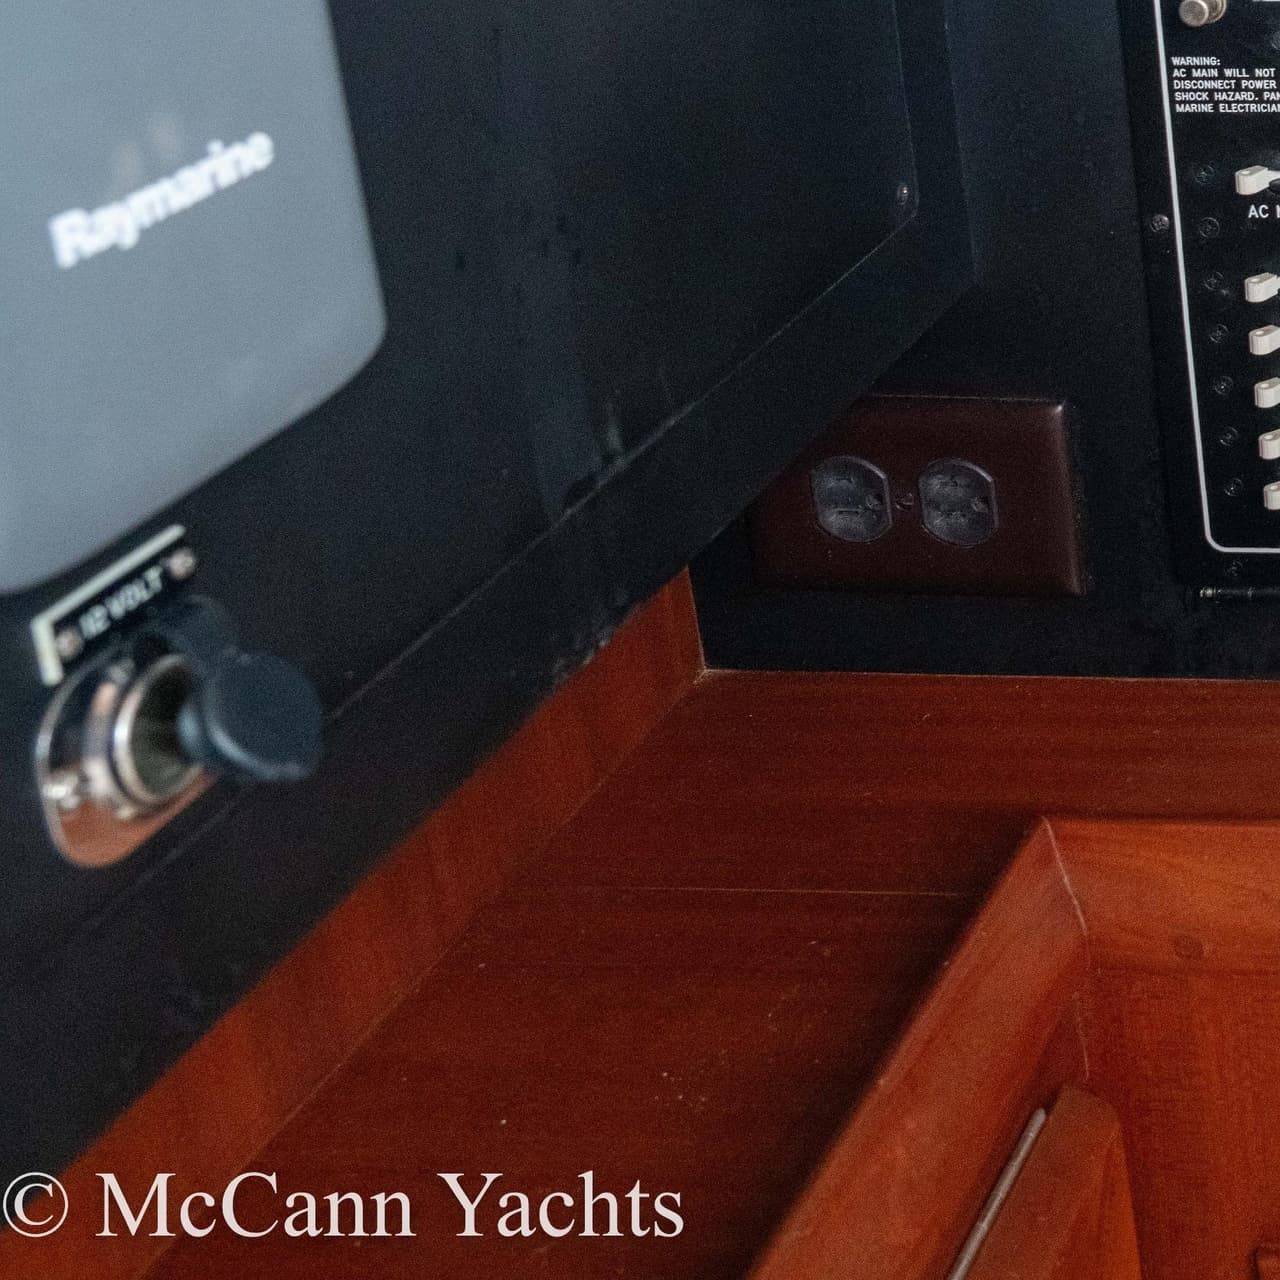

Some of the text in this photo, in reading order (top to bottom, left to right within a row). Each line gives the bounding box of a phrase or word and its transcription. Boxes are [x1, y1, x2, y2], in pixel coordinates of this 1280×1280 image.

[1172, 57, 1220, 65] WARNING:
[1174, 81, 1236, 89] DISCONNECT
[1242, 80, 1276, 89] POWER
[1176, 104, 1213, 113] MARINE
[1248, 205, 1268, 218] AC
